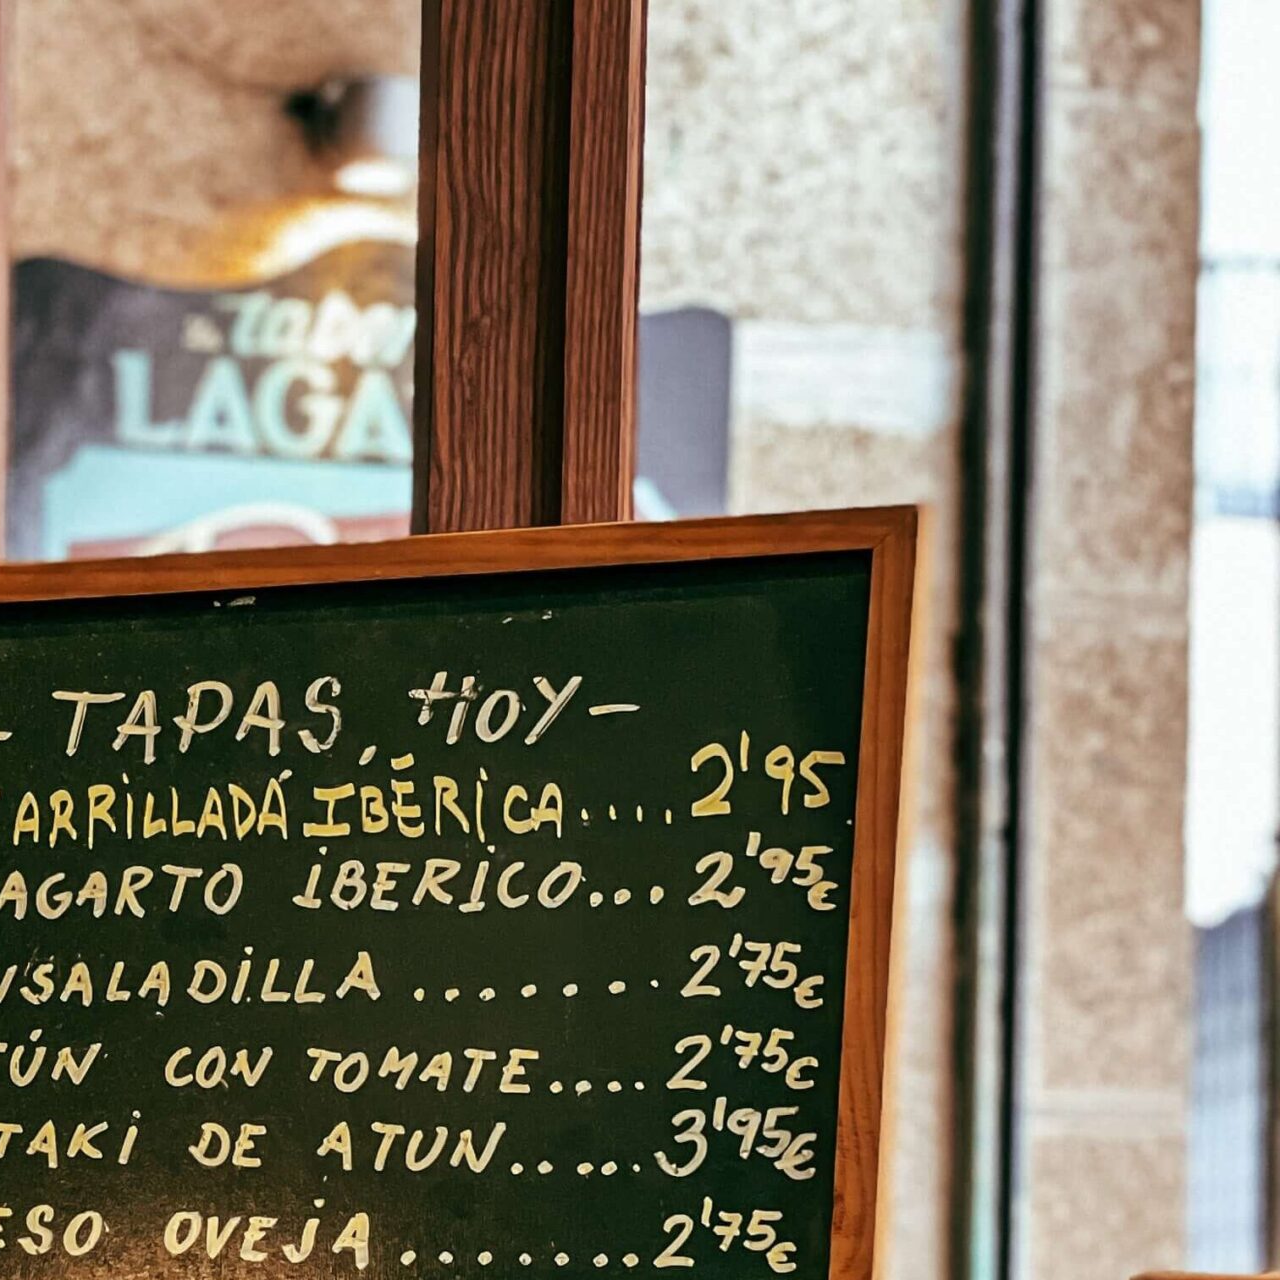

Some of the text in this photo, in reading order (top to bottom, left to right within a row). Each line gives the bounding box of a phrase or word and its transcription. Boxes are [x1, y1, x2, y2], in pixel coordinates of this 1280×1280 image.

[164, 1045, 273, 1089] CON
[306, 1046, 540, 1094] TOMATE
[188, 1122, 267, 1168] DE
[316, 1121, 507, 1173] ATUN
[159, 1198, 370, 1273] OVEJA
